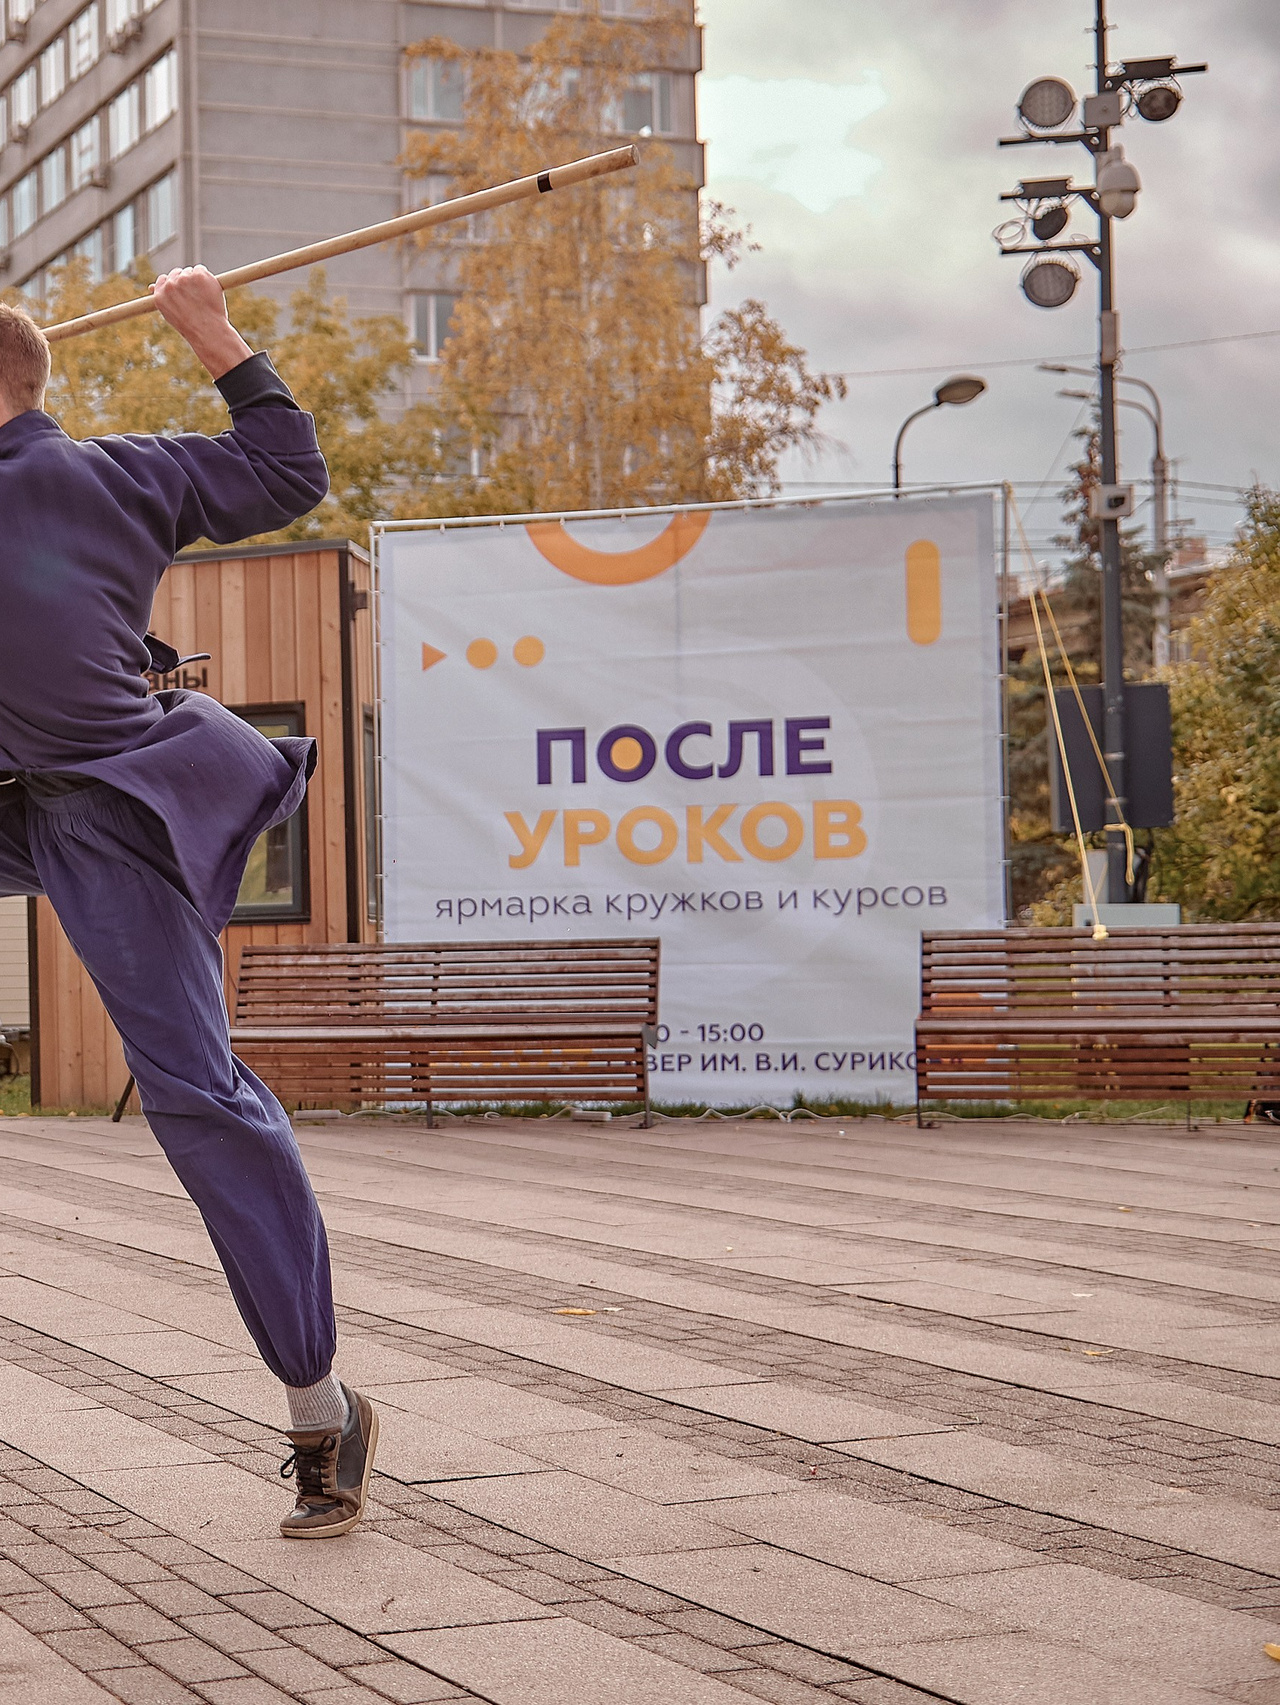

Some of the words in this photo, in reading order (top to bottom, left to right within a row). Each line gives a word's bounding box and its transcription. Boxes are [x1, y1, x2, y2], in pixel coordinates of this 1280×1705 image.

[535, 714, 834, 786] ПОСЛЕ
[503, 800, 869, 870] УРОКОВ
[435, 893, 593, 925] ярмарка
[605, 889, 765, 921] кружков
[778, 889, 799, 910] и
[812, 885, 948, 916] курсов
[697, 1023, 765, 1043] 15:00
[701, 1053, 747, 1072] ИМ.
[756, 1052, 806, 1072] В.И.
